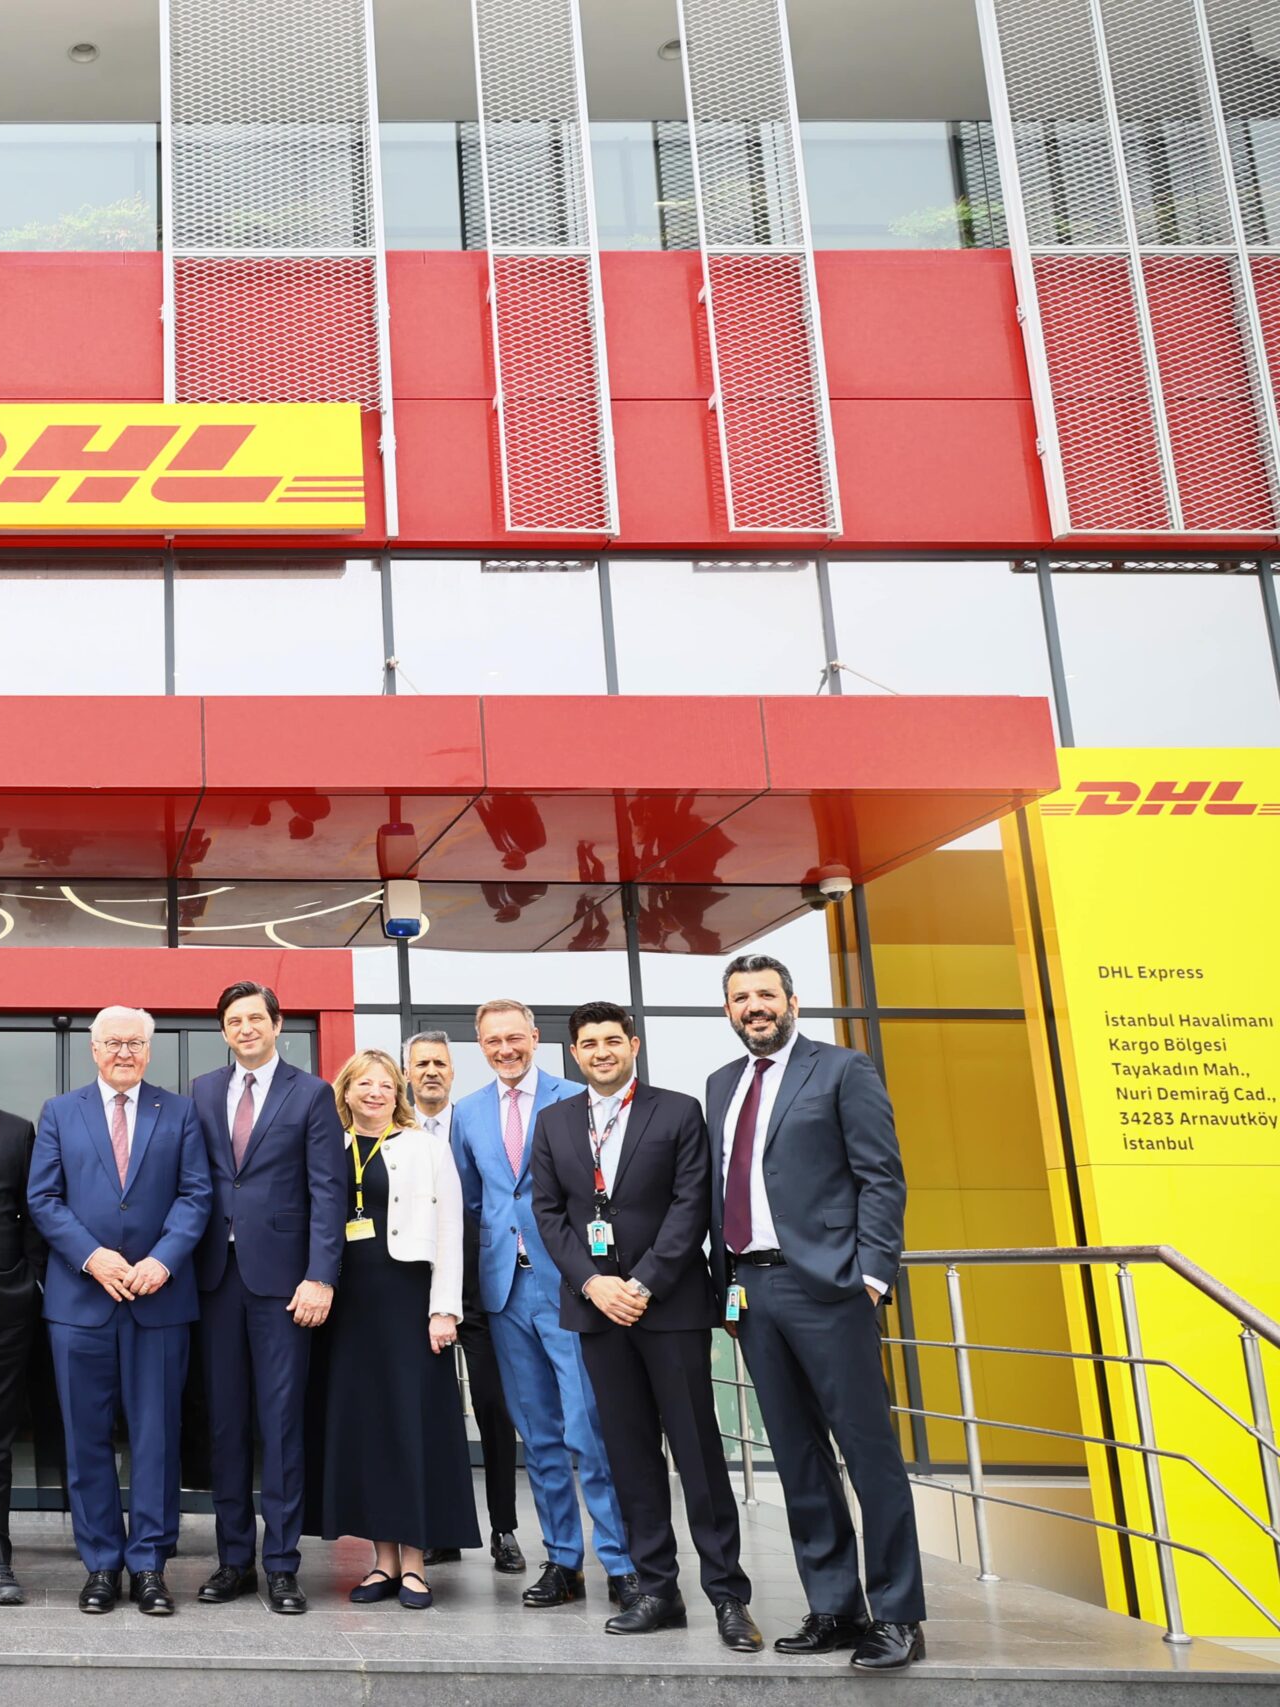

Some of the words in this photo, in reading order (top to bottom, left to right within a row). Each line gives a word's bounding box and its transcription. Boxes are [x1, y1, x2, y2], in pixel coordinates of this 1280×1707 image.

[1074, 781, 1258, 816] DHL
[1098, 965, 1134, 979] DHL
[1137, 965, 1204, 982] Express
[1104, 1010, 1175, 1027] İstanbul
[1178, 1013, 1274, 1028] Havalimanı
[1108, 1038, 1160, 1055] Kargo
[1164, 1037, 1227, 1055] Bölgesi
[1111, 1062, 1199, 1079] Tayakadın
[1203, 1062, 1250, 1078] Mah.,
[1115, 1086, 1153, 1101] Nuri
[1156, 1086, 1230, 1105] Demirağ
[1233, 1087, 1277, 1103] Cad.,
[1119, 1111, 1175, 1126] 34283
[1179, 1111, 1278, 1129] Arnavutköy
[1122, 1134, 1194, 1151] İstanbul
